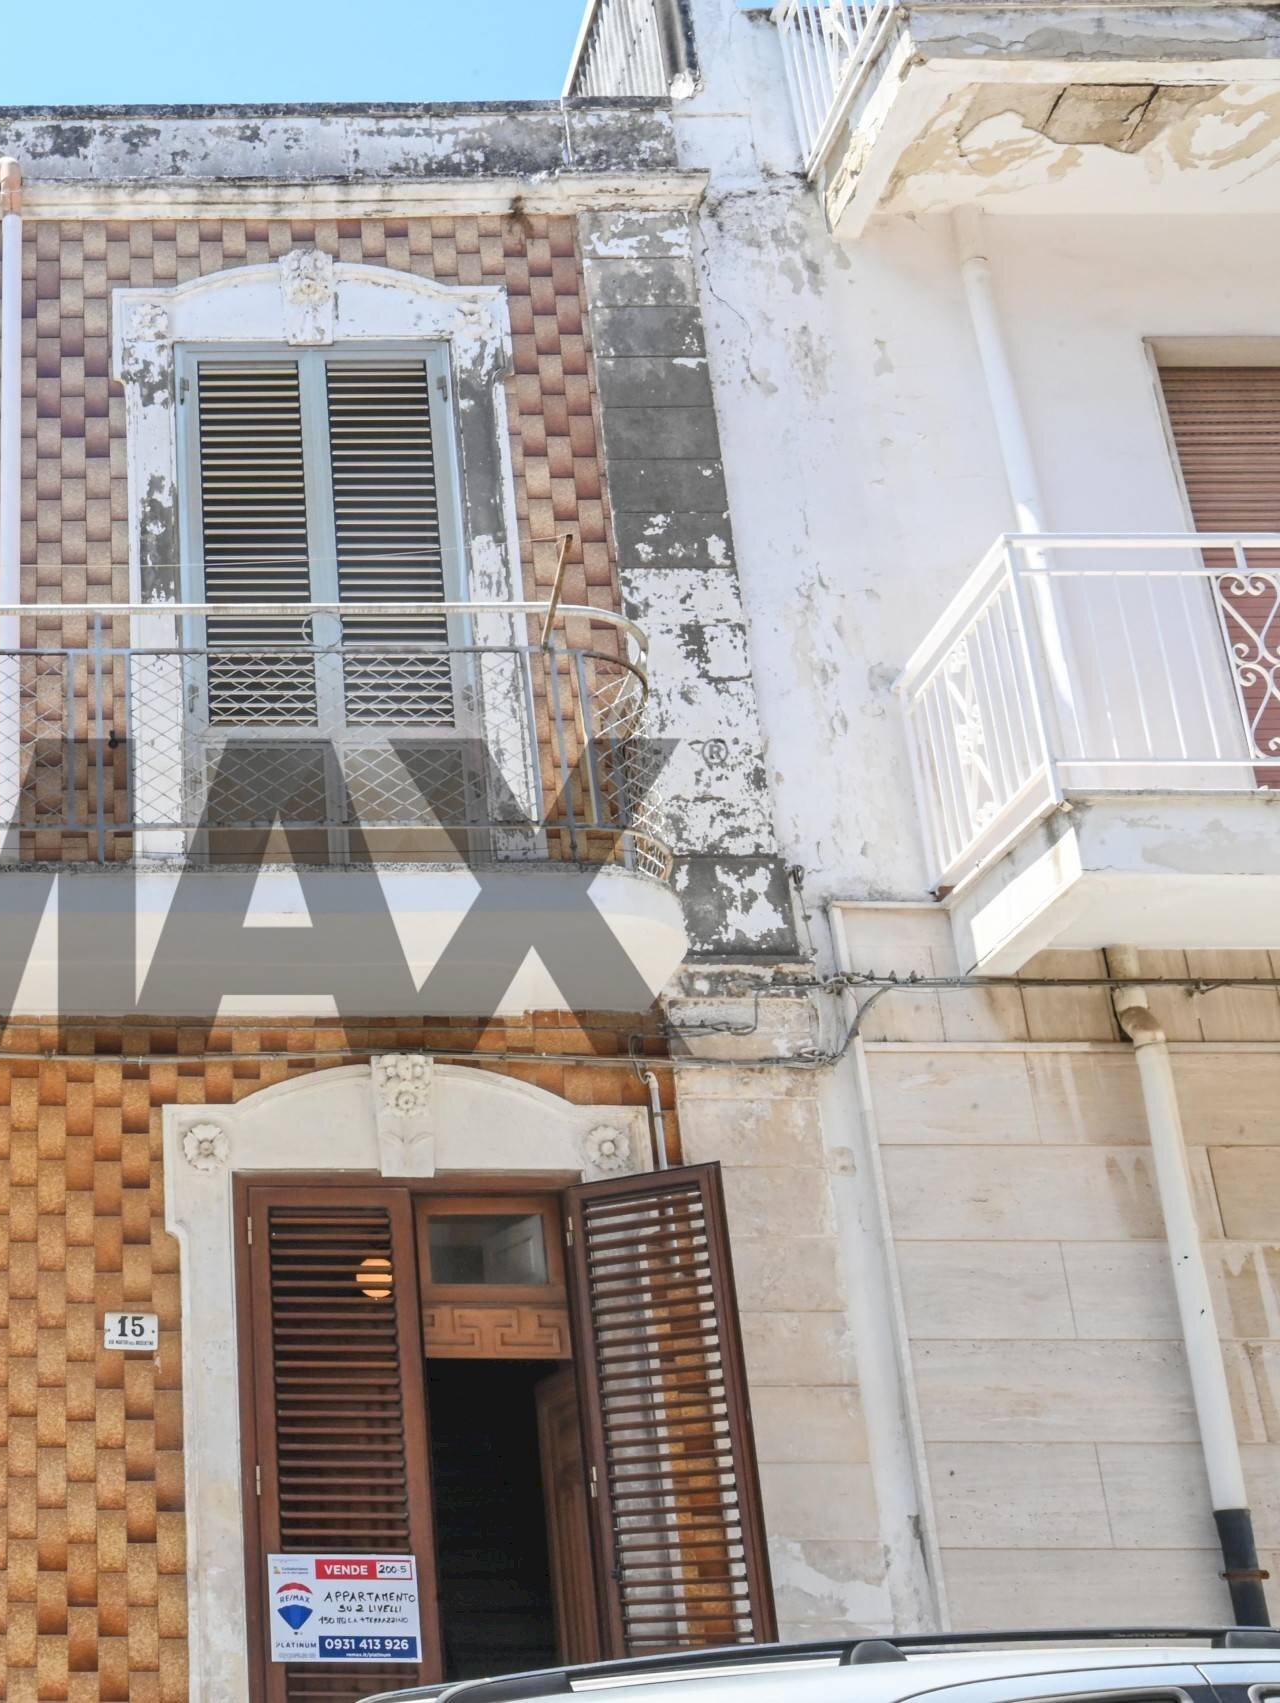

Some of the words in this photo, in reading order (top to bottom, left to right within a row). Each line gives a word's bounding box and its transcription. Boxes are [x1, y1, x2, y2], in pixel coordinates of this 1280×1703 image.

[118, 1315, 145, 1337] 15
[323, 1564, 368, 1575] VENDE
[279, 1594, 311, 1603] RE/MAX
[324, 1590, 416, 1602] APPARTAMENTO
[338, 1604, 352, 1613] SU
[355, 1604, 364, 1613] 2
[368, 1604, 402, 1613] LIVELLI
[324, 1638, 356, 1650] 0931
[359, 1638, 381, 1650] 413
[384, 1639, 409, 1650] 926
